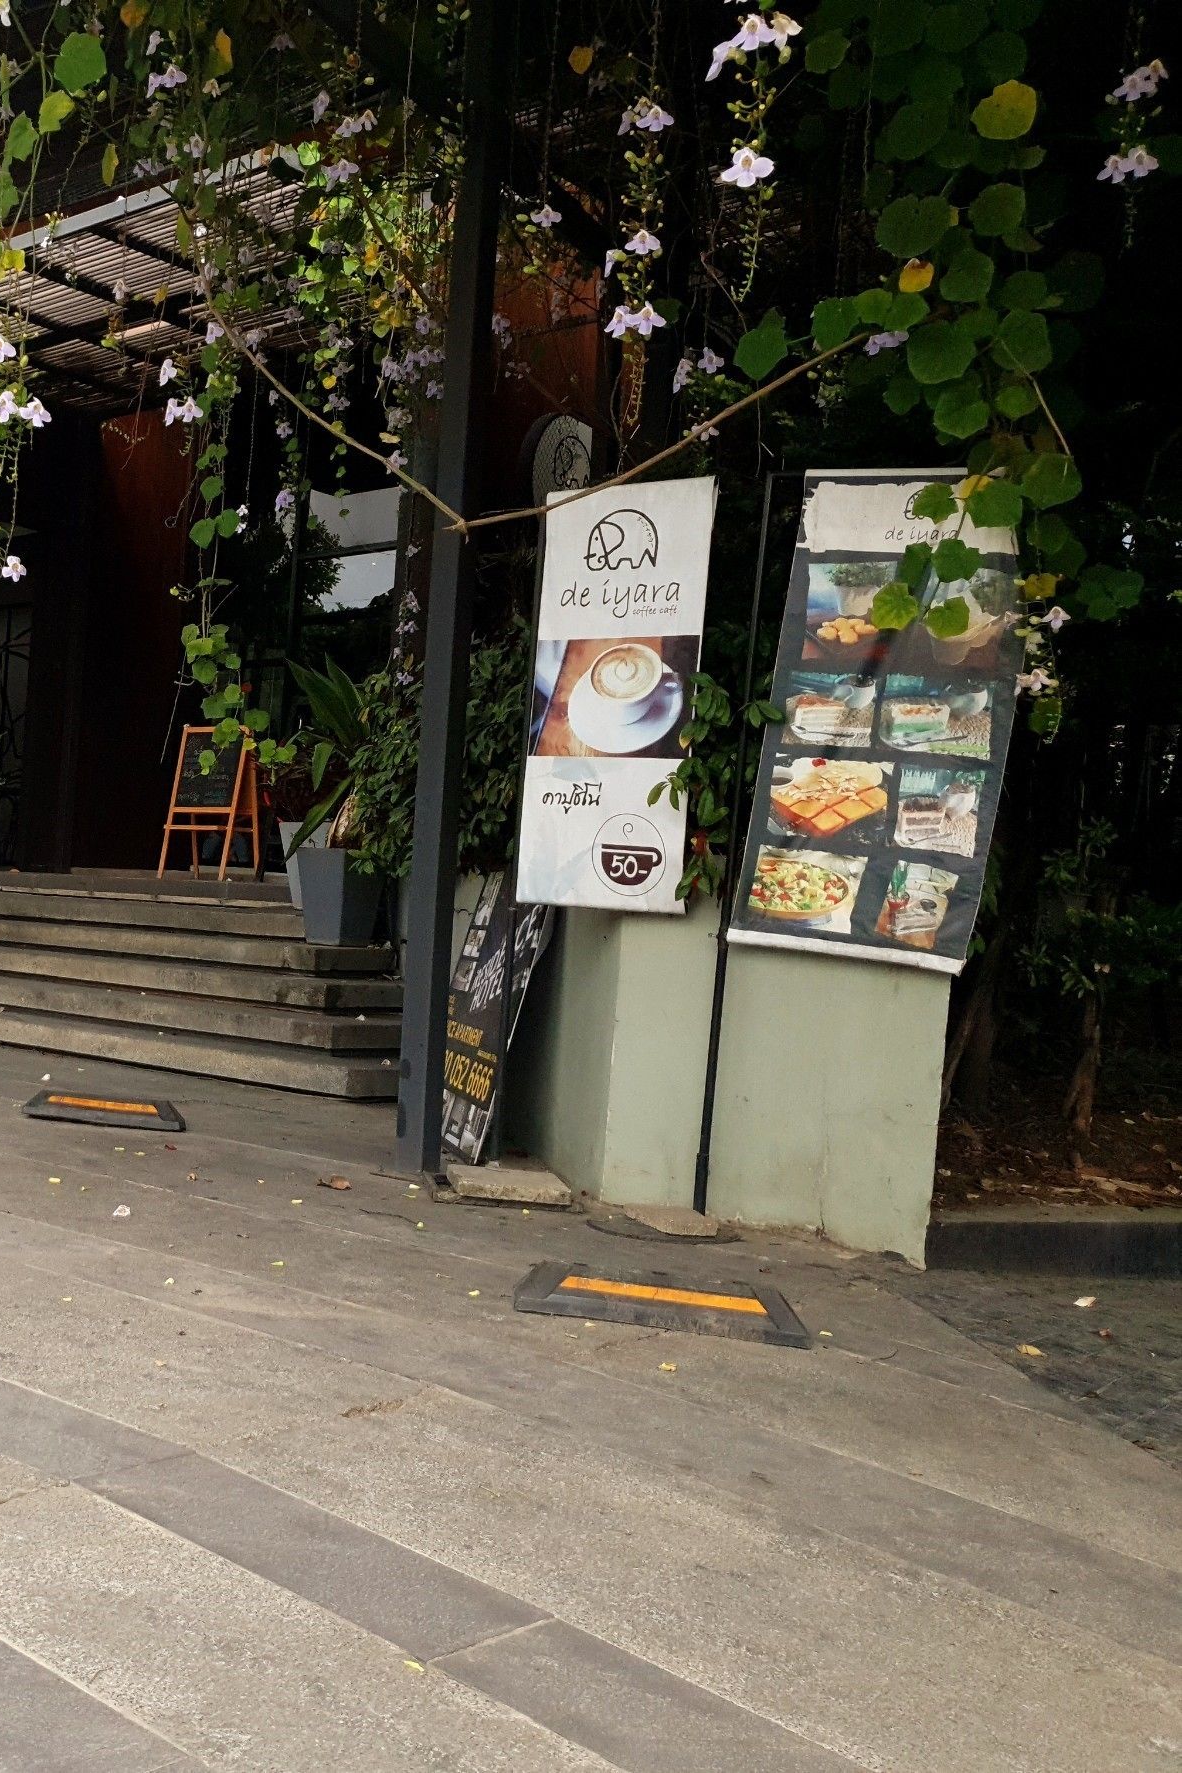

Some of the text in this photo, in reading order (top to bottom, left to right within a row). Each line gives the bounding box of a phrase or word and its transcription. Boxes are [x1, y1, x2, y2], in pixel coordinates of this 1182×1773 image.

[884, 526, 903, 541] de
[560, 579, 681, 618] de iyara
[632, 606, 657, 617] coffee
[466, 1061, 494, 1102] 6666
